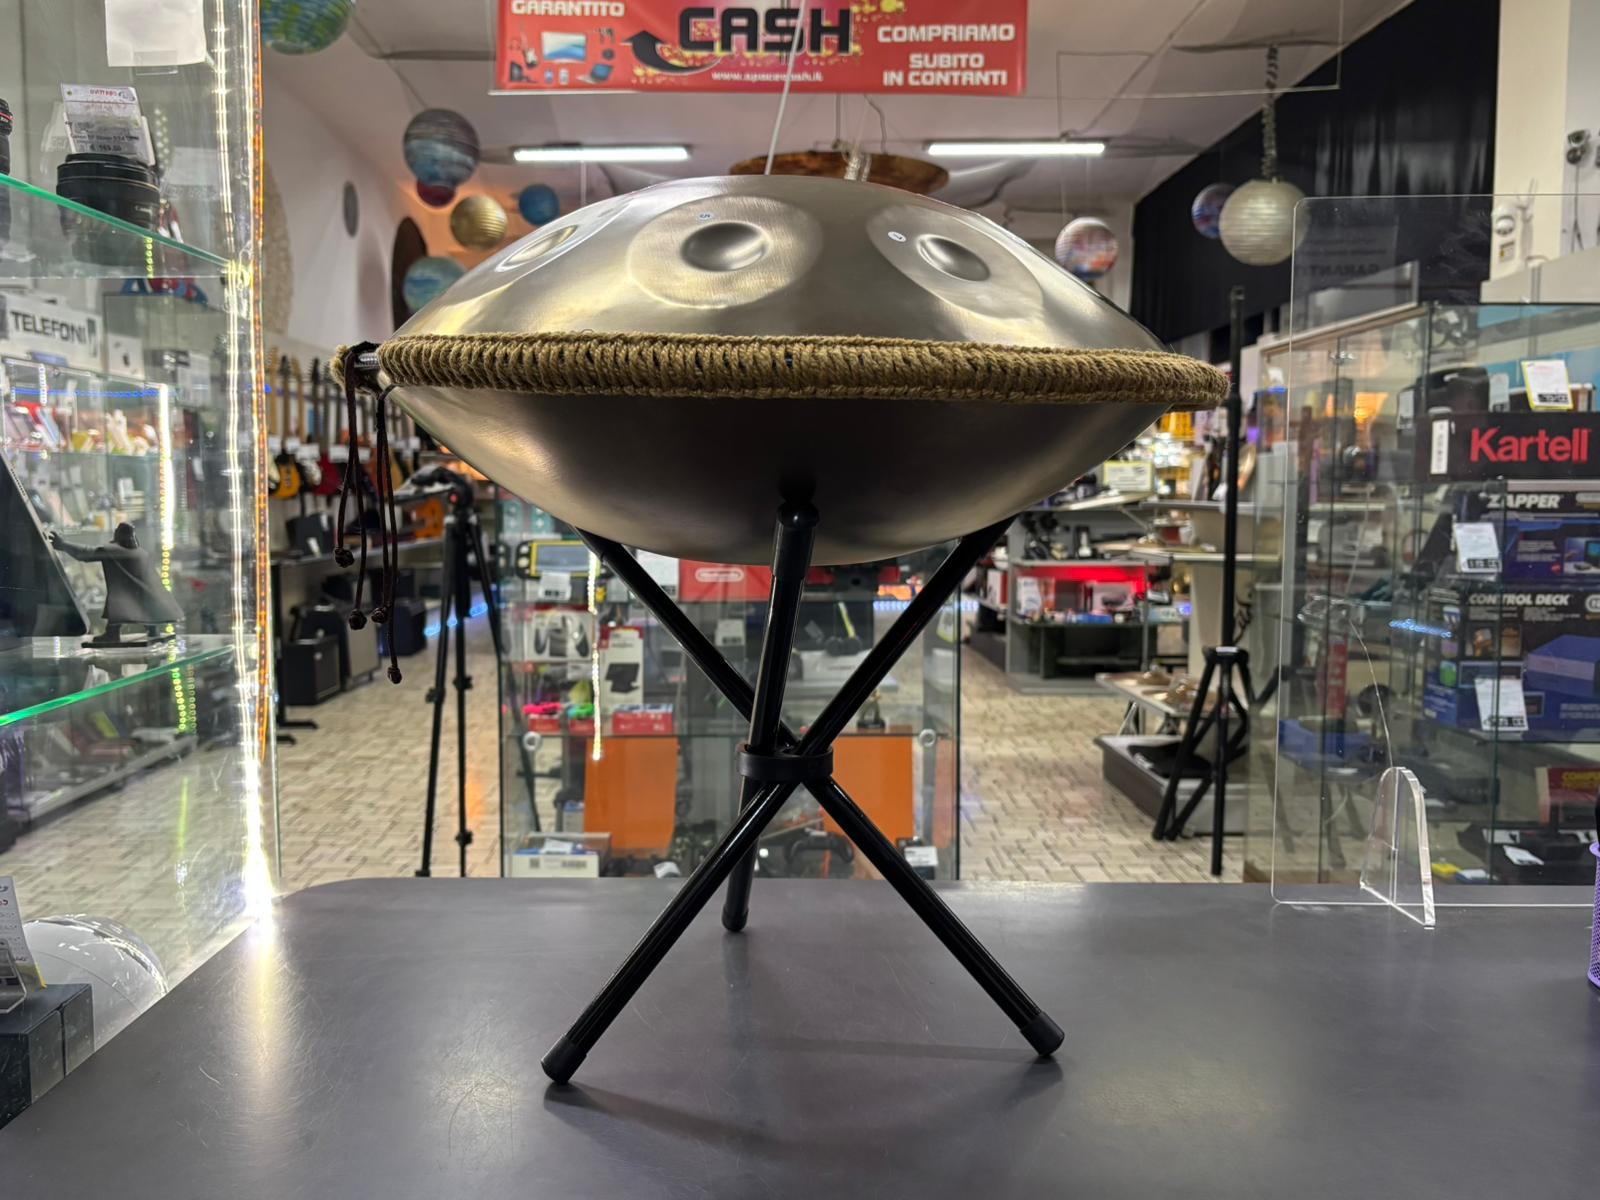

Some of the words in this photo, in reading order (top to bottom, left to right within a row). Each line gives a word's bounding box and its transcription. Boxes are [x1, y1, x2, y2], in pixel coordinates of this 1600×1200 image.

[511, 0, 625, 17] GARANTITO
[877, 24, 1016, 43] COMPRIAMO
[908, 53, 985, 69] SUBITO
[882, 70, 904, 86] IN
[907, 69, 1008, 86] CONTANTI
[10, 310, 87, 344] TELEFONI
[1470, 427, 1590, 464] Kartell
[1486, 494, 1561, 509] ZAPPER
[1468, 594, 1534, 606] CONTROL
[1535, 594, 1571, 606] DECK
